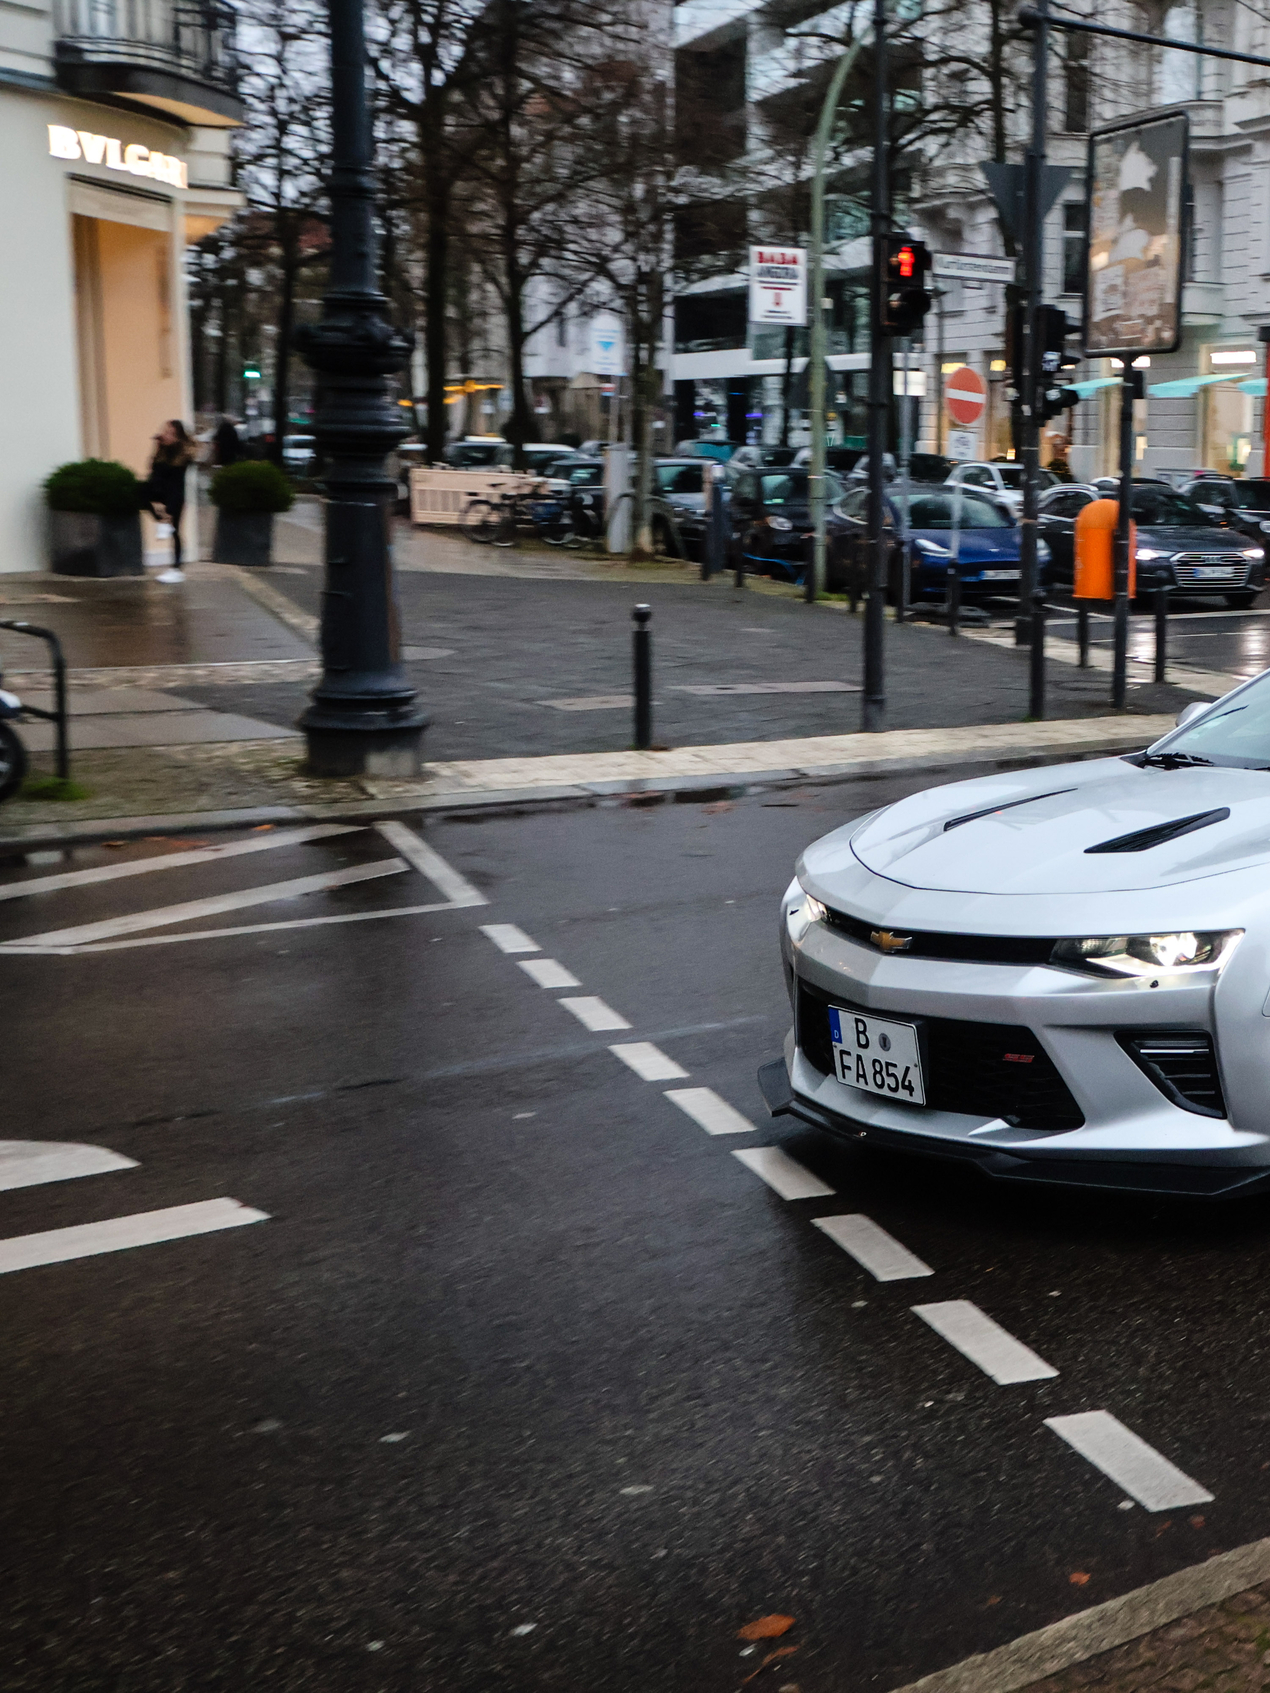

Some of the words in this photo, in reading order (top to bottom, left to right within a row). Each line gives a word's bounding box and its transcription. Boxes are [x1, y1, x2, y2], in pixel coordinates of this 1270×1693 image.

[46, 124, 188, 189] BVLGARI
[833, 1029, 840, 1039] D
[854, 1017, 870, 1049] B
